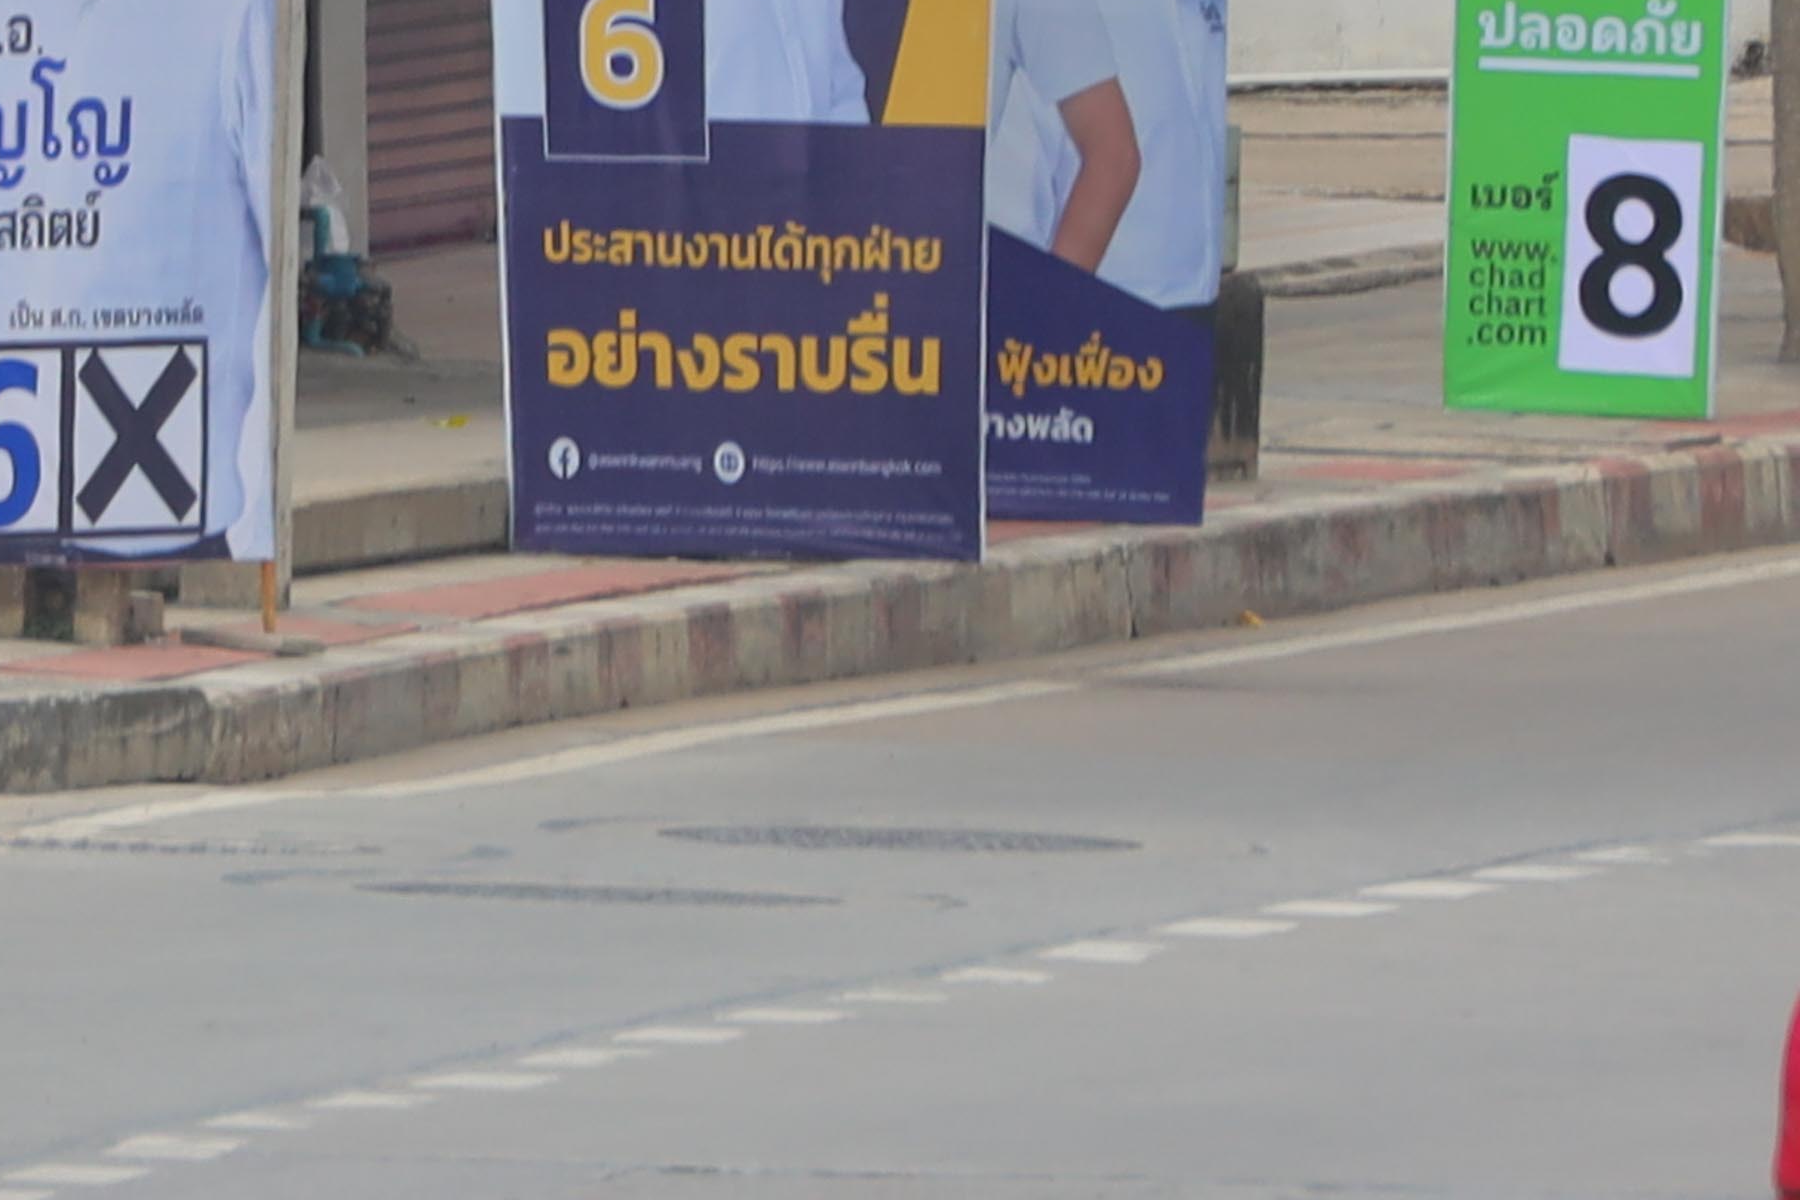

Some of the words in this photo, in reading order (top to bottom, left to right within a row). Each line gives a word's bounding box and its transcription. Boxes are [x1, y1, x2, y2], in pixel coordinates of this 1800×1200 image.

[543, 219, 942, 285] ประสานงานได้ทุกฝ่าย
[1470, 171, 1560, 211] เบอร์
[1578, 172, 1684, 340] 8
[1472, 238, 1557, 263] www.
[1469, 262, 1546, 289] chad
[1469, 290, 1547, 318] chart
[546, 292, 941, 395] อย่างราบรื่น
[1467, 322, 1547, 346] .com
[997, 330, 1165, 399] ฟุ้งเฟื่อง
[985, 406, 1094, 443] างพลัด
